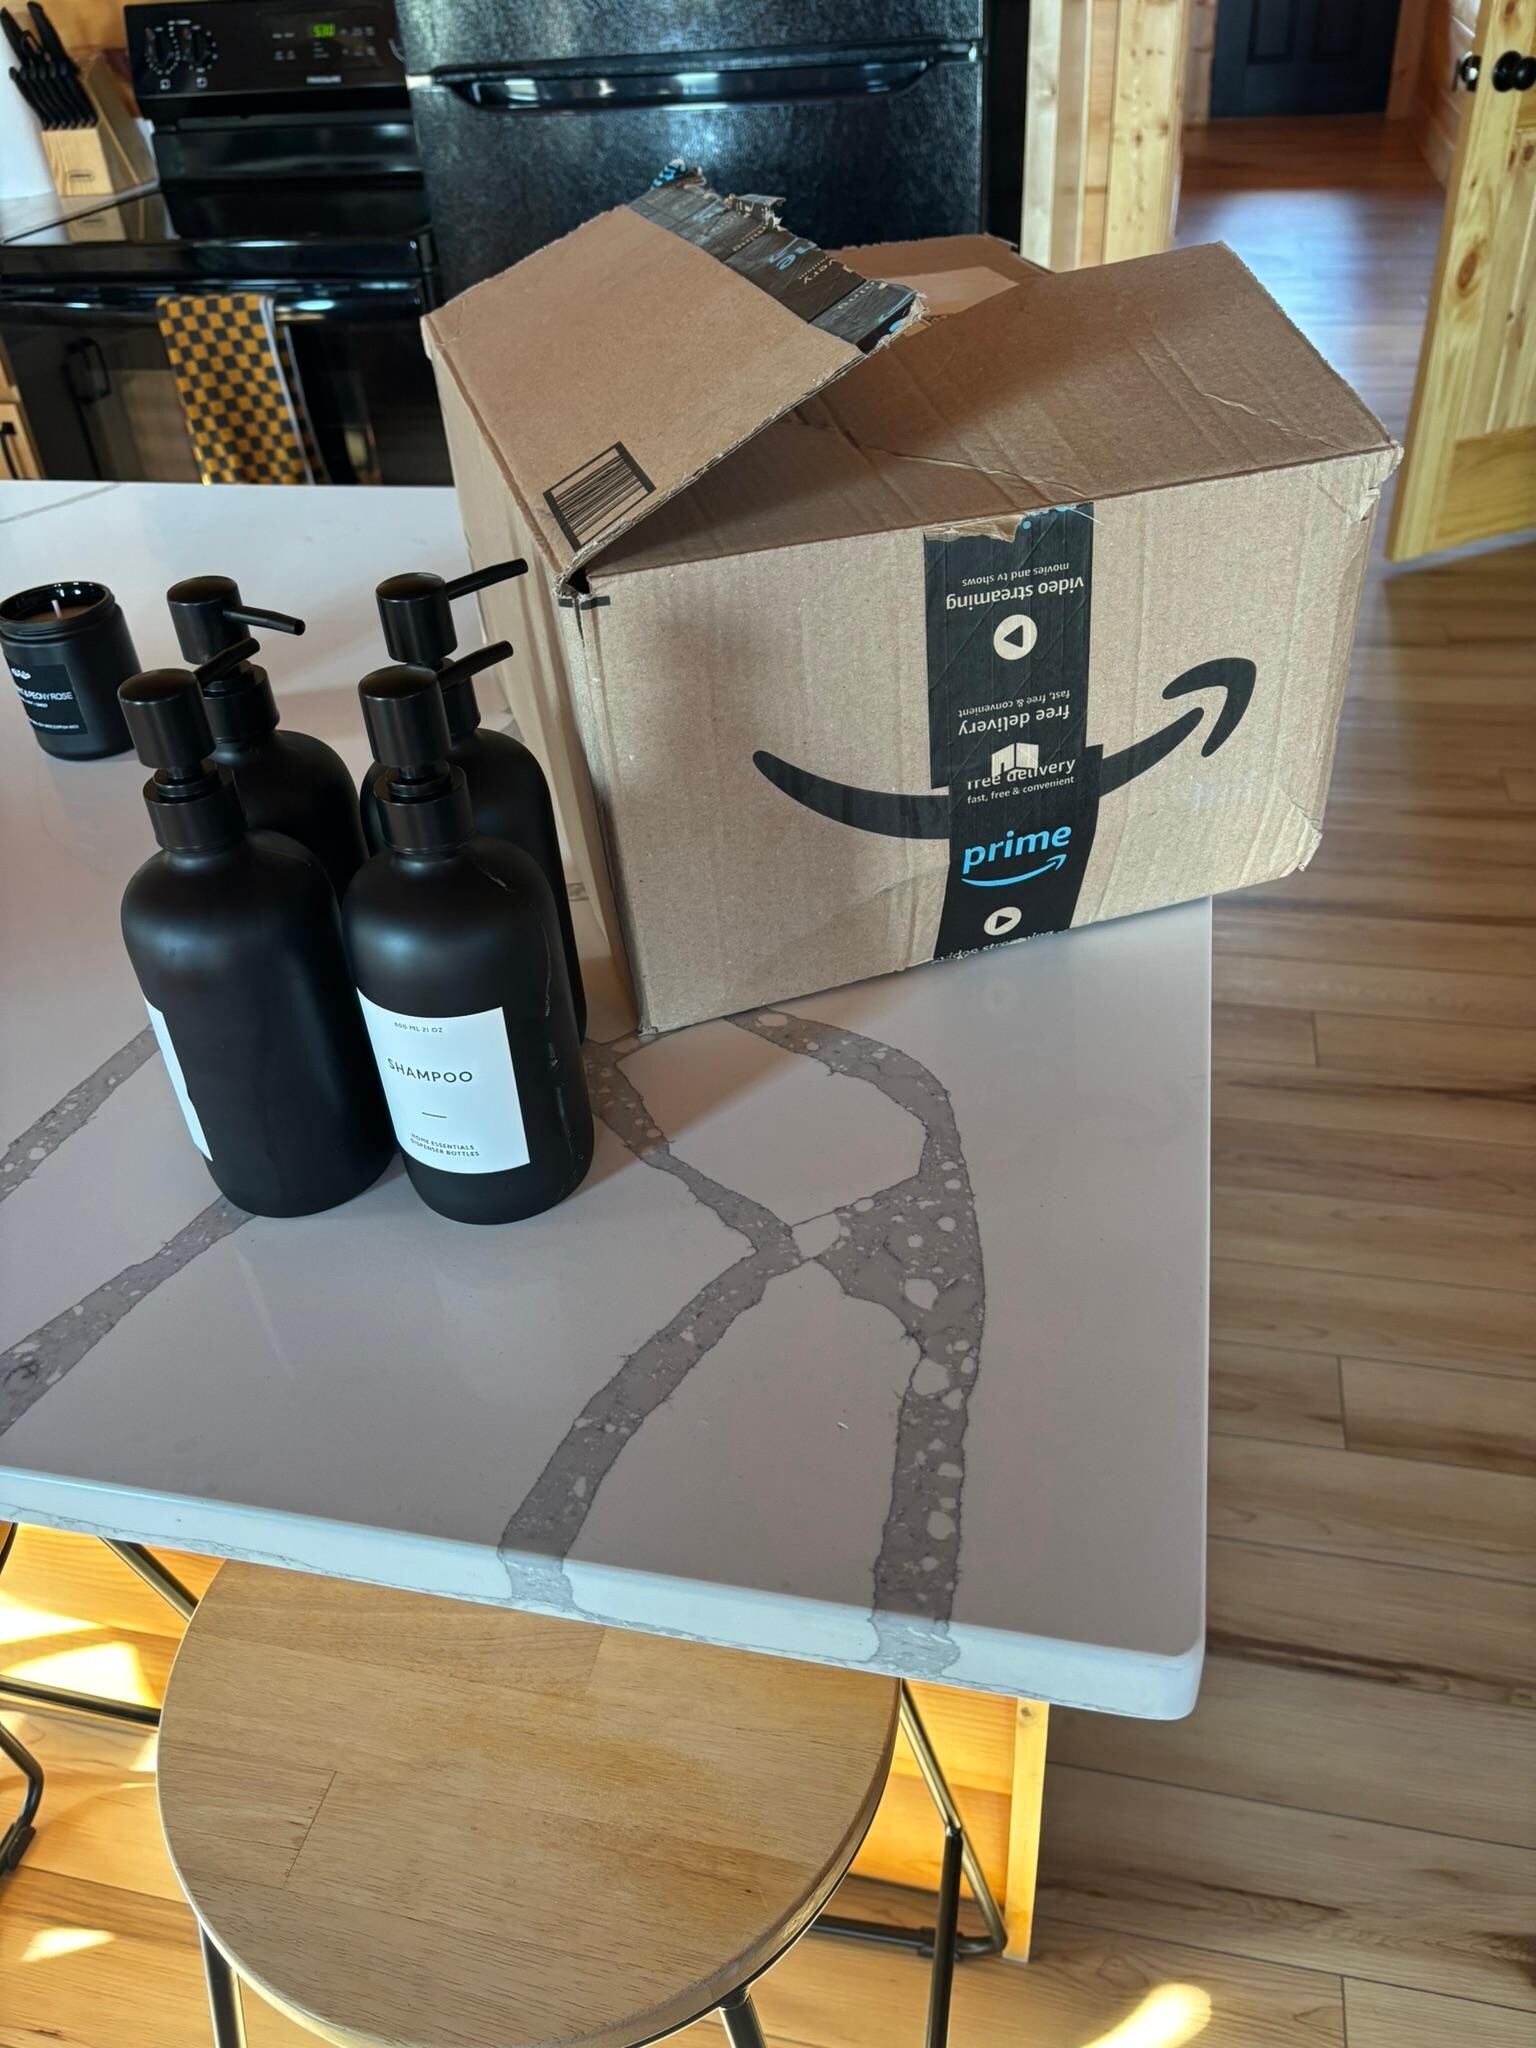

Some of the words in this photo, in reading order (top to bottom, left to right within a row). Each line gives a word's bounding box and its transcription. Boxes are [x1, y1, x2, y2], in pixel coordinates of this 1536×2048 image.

[997, 571, 1008, 582] tv
[1010, 568, 1031, 581] and
[1033, 562, 1070, 575] movies
[961, 574, 995, 586] shows
[1038, 576, 1085, 596] video
[946, 584, 1034, 611] streaming
[50, 691, 73, 700] ROSE
[1016, 698, 1025, 707] &
[1026, 694, 1046, 705] free
[1049, 689, 1070, 700] fast,
[958, 701, 1014, 716] convenient
[1035, 704, 1070, 721] free
[958, 712, 1030, 736] delivery
[967, 794, 988, 805] fast,
[991, 790, 1010, 800] free
[1012, 787, 1020, 796] &
[1022, 776, 1075, 793] convenient
[962, 825, 1072, 874] prime
[387, 1057, 473, 1083] SHAMPOO
[410, 1137, 445, 1155] DISPENSER
[445, 1148, 480, 1157] BOTTLES
[411, 1132, 430, 1145] HOME
[430, 1141, 475, 1150] ESSENTIALS
